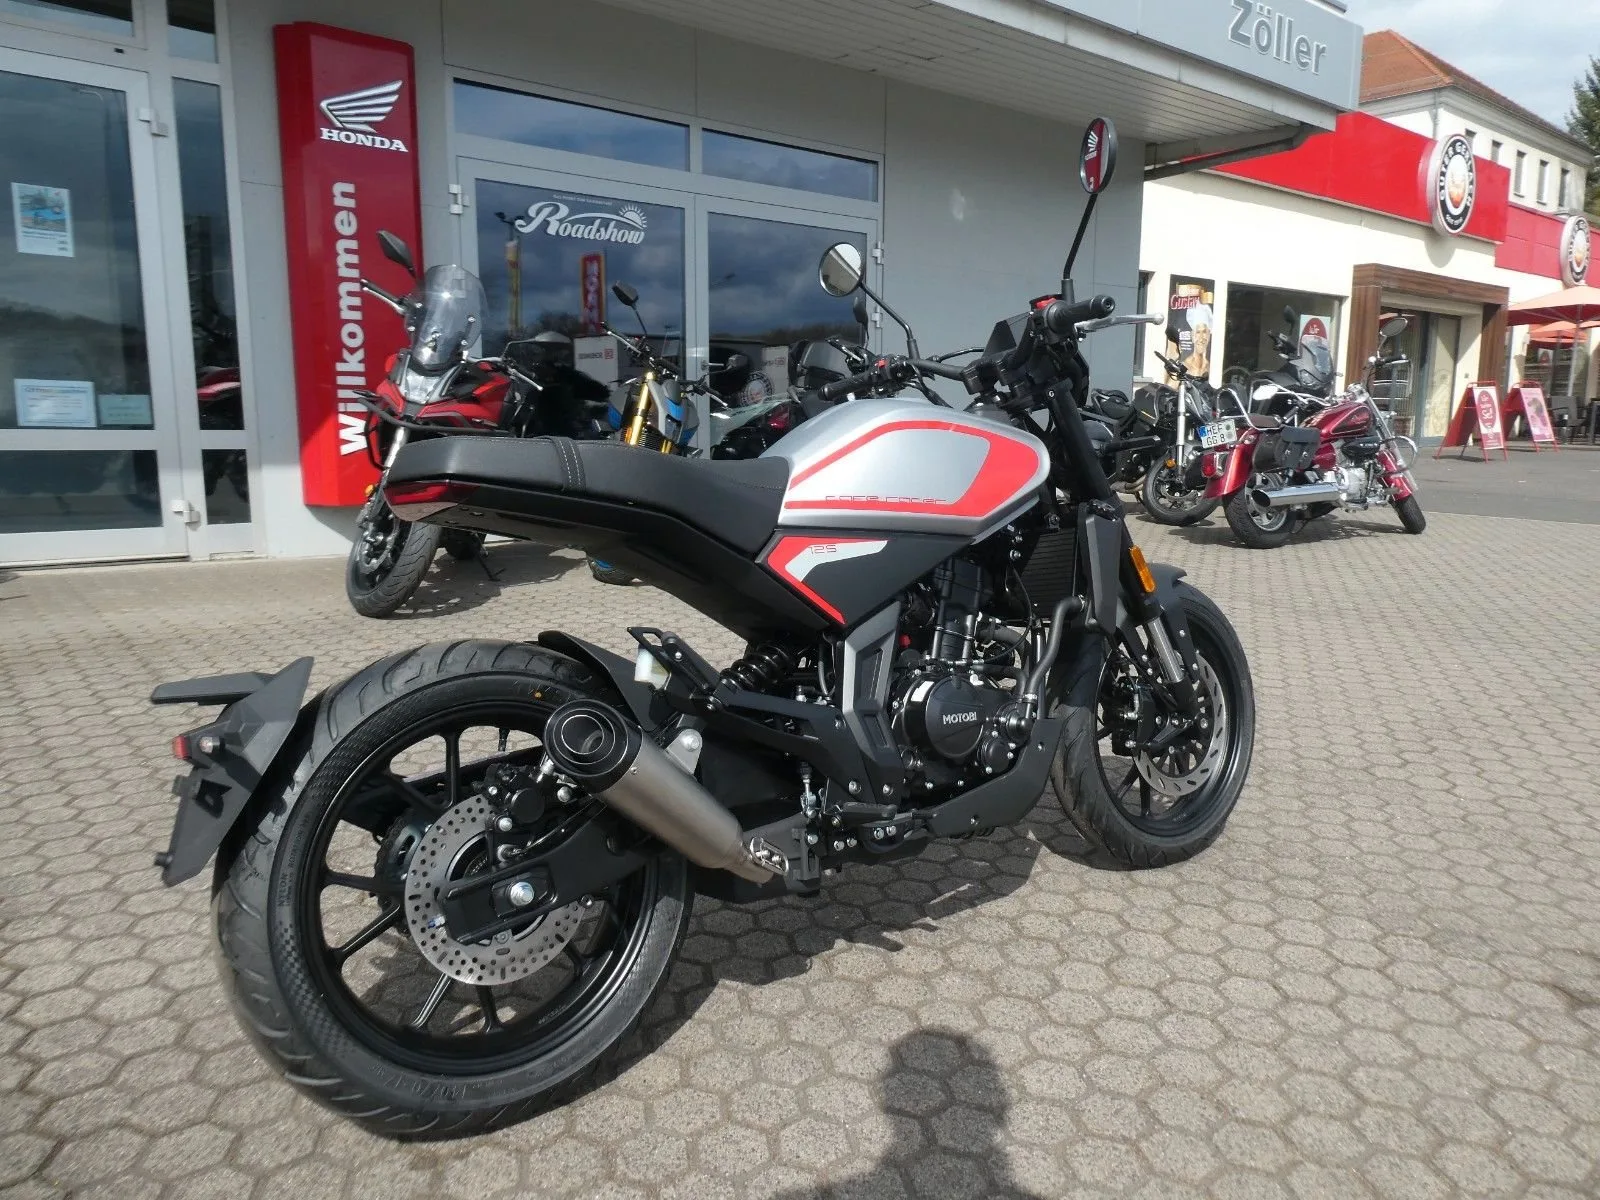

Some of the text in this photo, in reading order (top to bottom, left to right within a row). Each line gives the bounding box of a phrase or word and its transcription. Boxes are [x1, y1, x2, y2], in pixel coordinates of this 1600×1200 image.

[1229, 0, 1327, 75] Zöller
[320, 128, 408, 153] HONDA
[515, 201, 645, 244] Roadshow
[333, 181, 367, 456] Willkommen
[1219, 433, 1226, 443] 8
[808, 544, 837, 555] 125
[942, 711, 977, 725] MOTOBI
